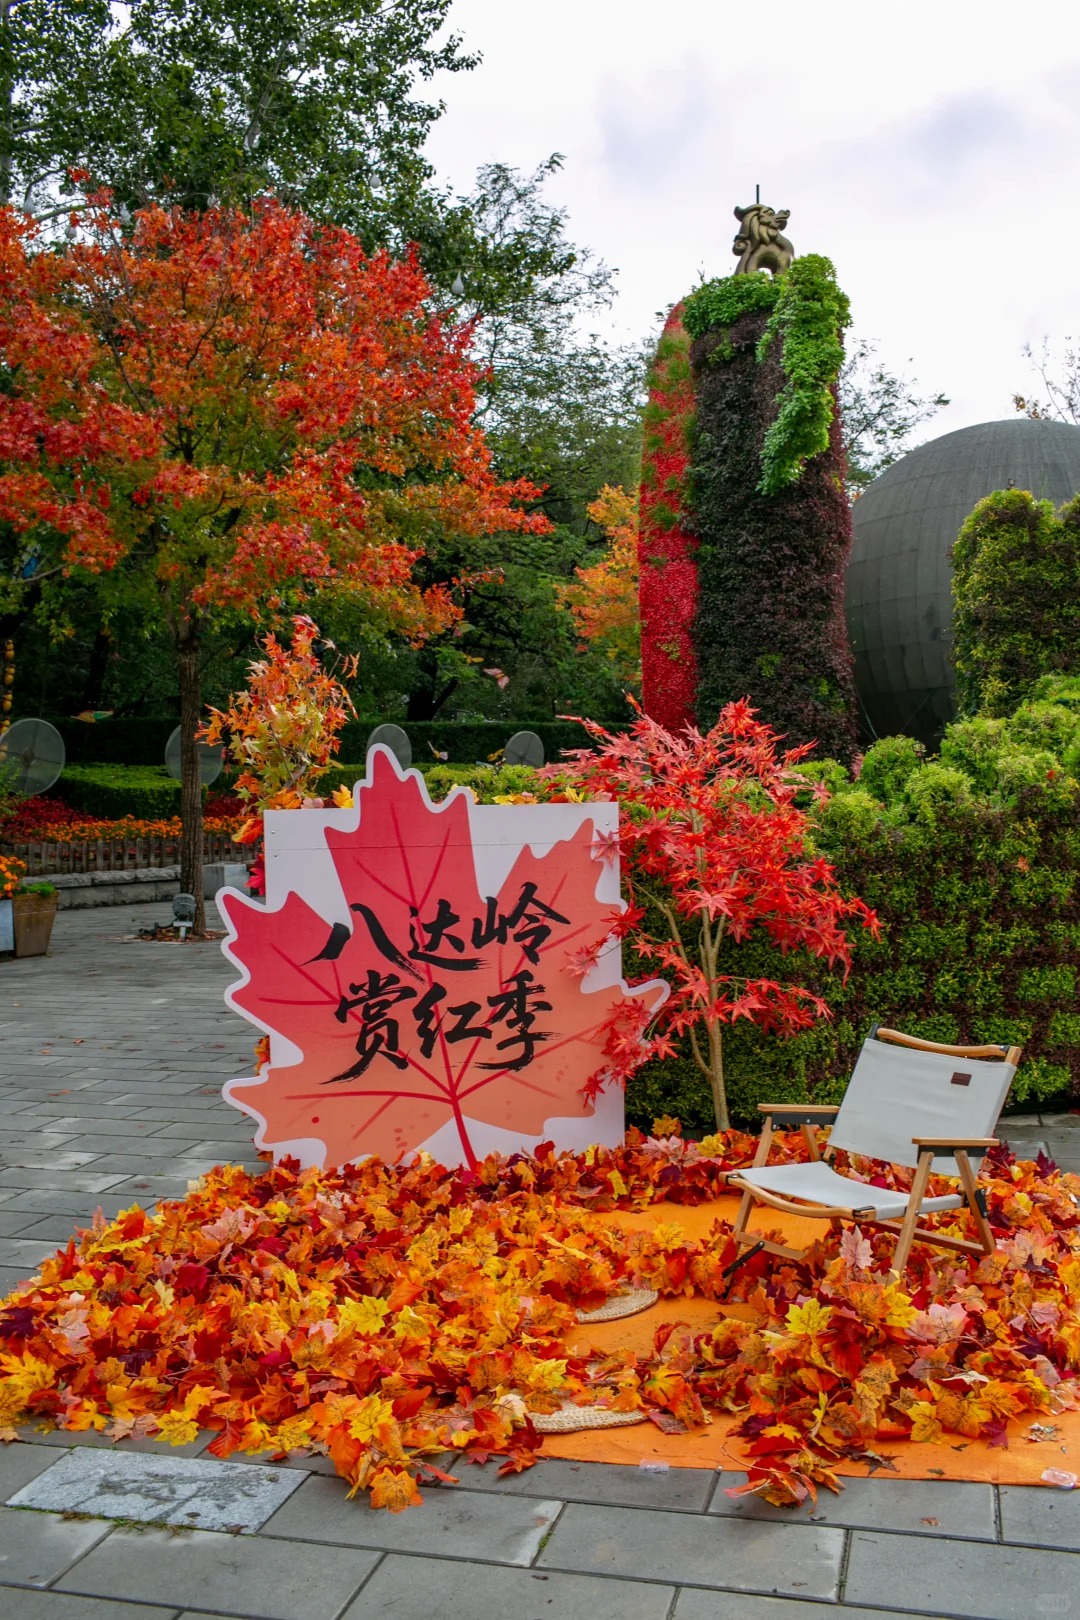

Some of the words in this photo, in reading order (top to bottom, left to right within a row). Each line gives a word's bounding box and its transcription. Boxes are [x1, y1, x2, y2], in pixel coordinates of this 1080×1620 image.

[302, 882, 571, 982] 八达岭
[320, 969, 561, 1085] 赏红季
